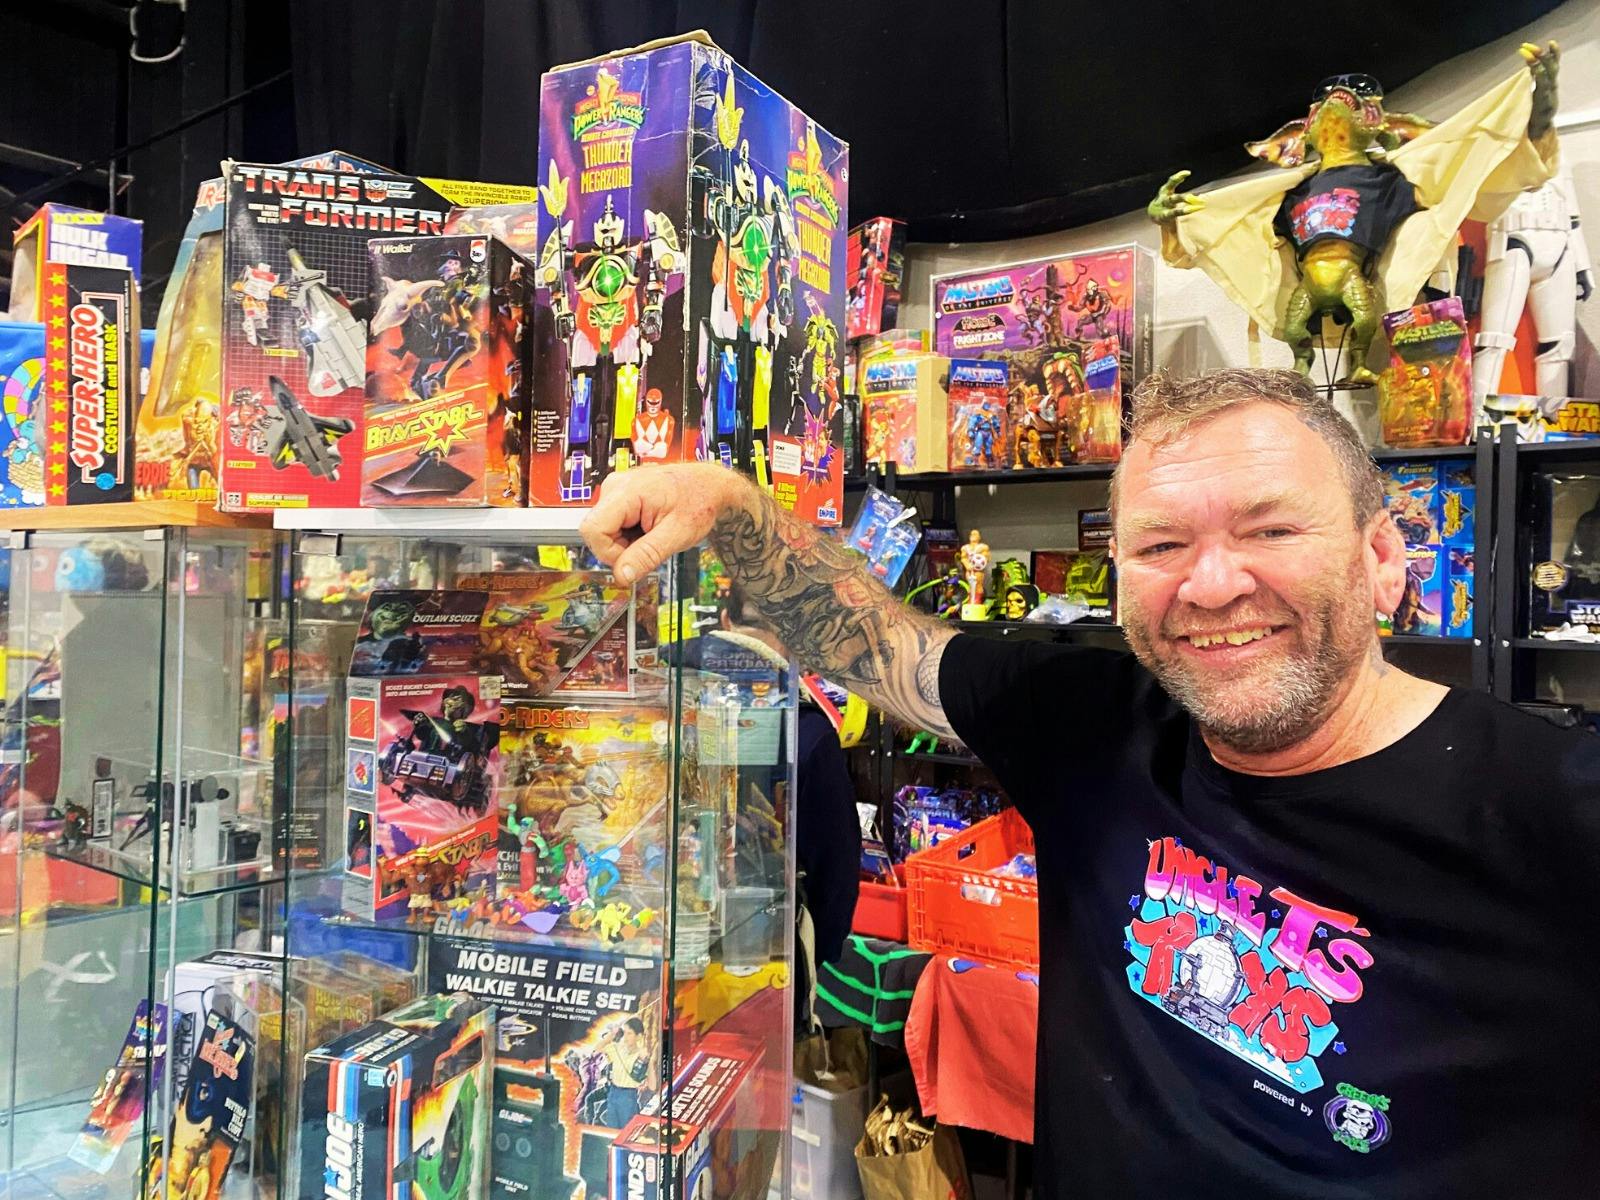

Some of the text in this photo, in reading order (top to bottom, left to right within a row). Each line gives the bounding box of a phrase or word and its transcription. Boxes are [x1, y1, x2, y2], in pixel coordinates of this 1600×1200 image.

[574, 109, 601, 131] POWER
[582, 138, 632, 169] THUNDER
[238, 165, 360, 202] TRANS
[580, 166, 632, 194] MEGAZORD
[281, 197, 449, 236] FORMER
[104, 324, 118, 454] COSTUME and MASK
[412, 614, 480, 623] OUTLAW SCUZZ
[1144, 836, 1266, 948] UNCLE
[457, 949, 628, 987] MOBILE FIELD
[446, 973, 637, 1011] WALKIE TALKIE SET
[556, 1005, 575, 1013] VOLUME
[688, 1057, 721, 1089] SOUNDS
[1253, 1080, 1314, 1117] powered by
[357, 1122, 365, 1143] HERO
[324, 1112, 357, 1191] JOE
[356, 1144, 364, 1184] AMERICAN
